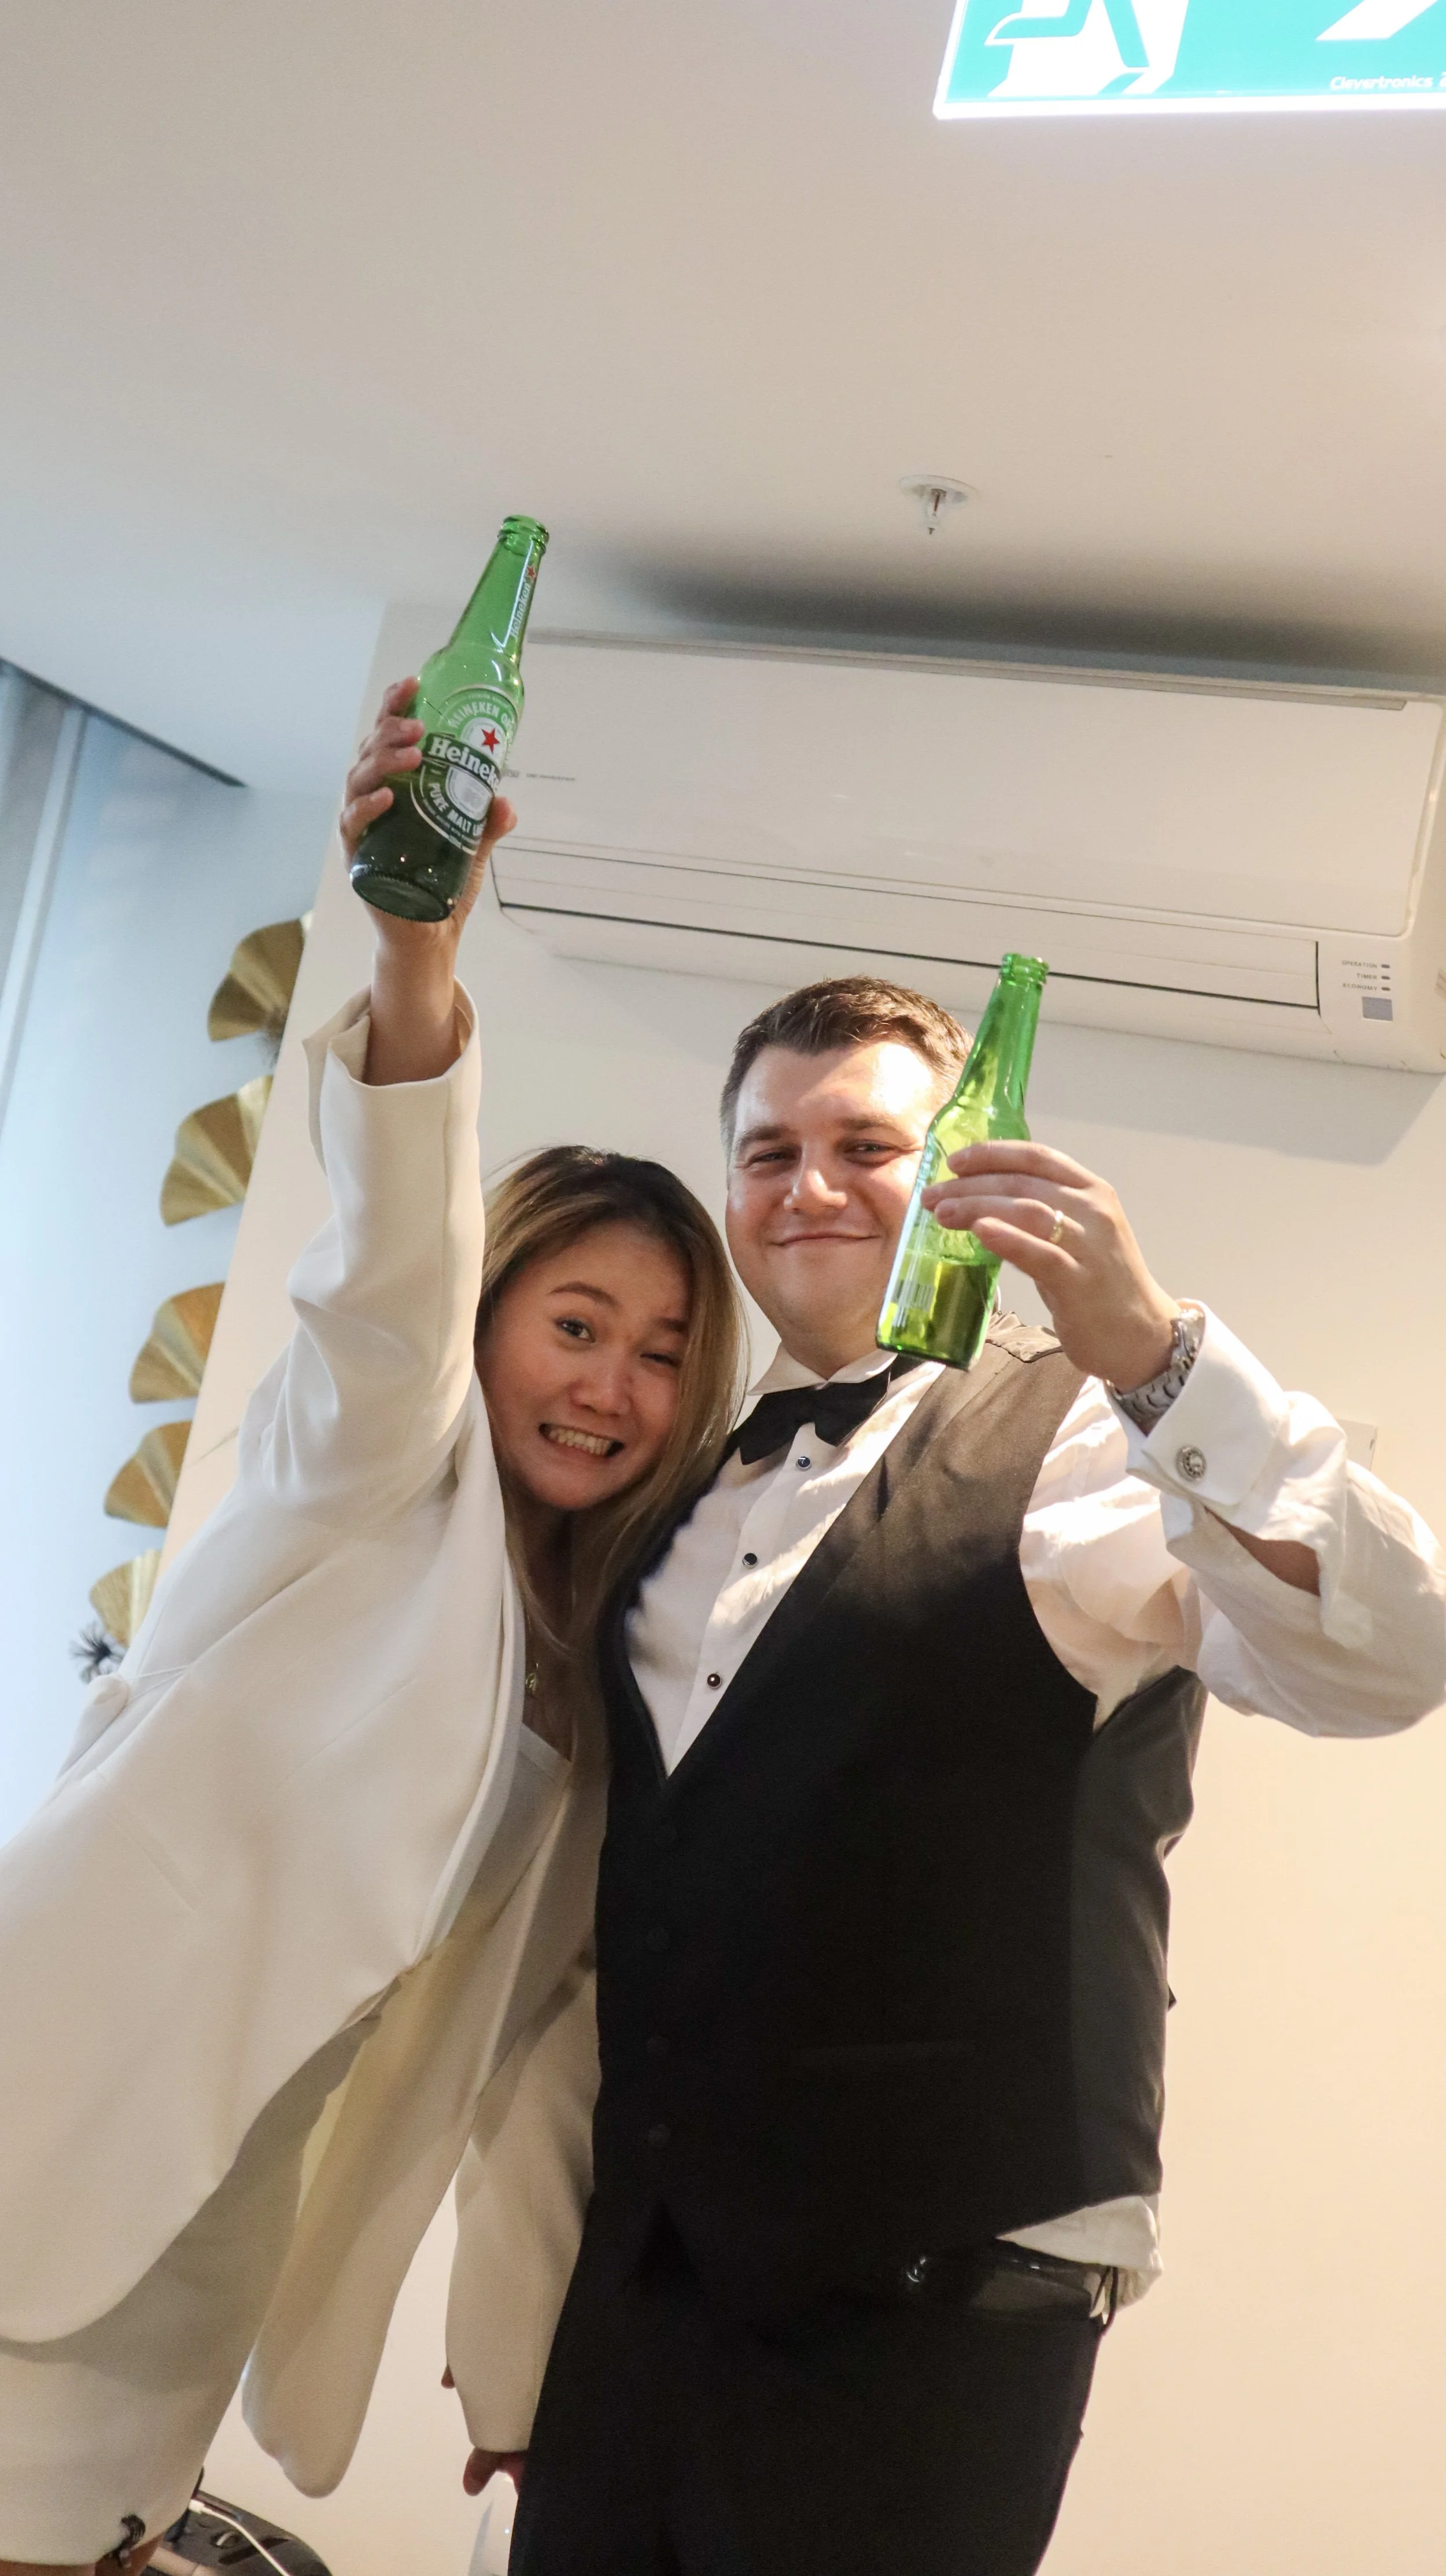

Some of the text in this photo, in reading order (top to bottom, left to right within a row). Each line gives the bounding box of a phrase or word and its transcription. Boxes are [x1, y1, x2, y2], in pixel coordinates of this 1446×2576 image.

[1330, 75, 1434, 90] Clevertronics
[428, 782, 449, 812] PURE
[447, 809, 472, 833] MALT
